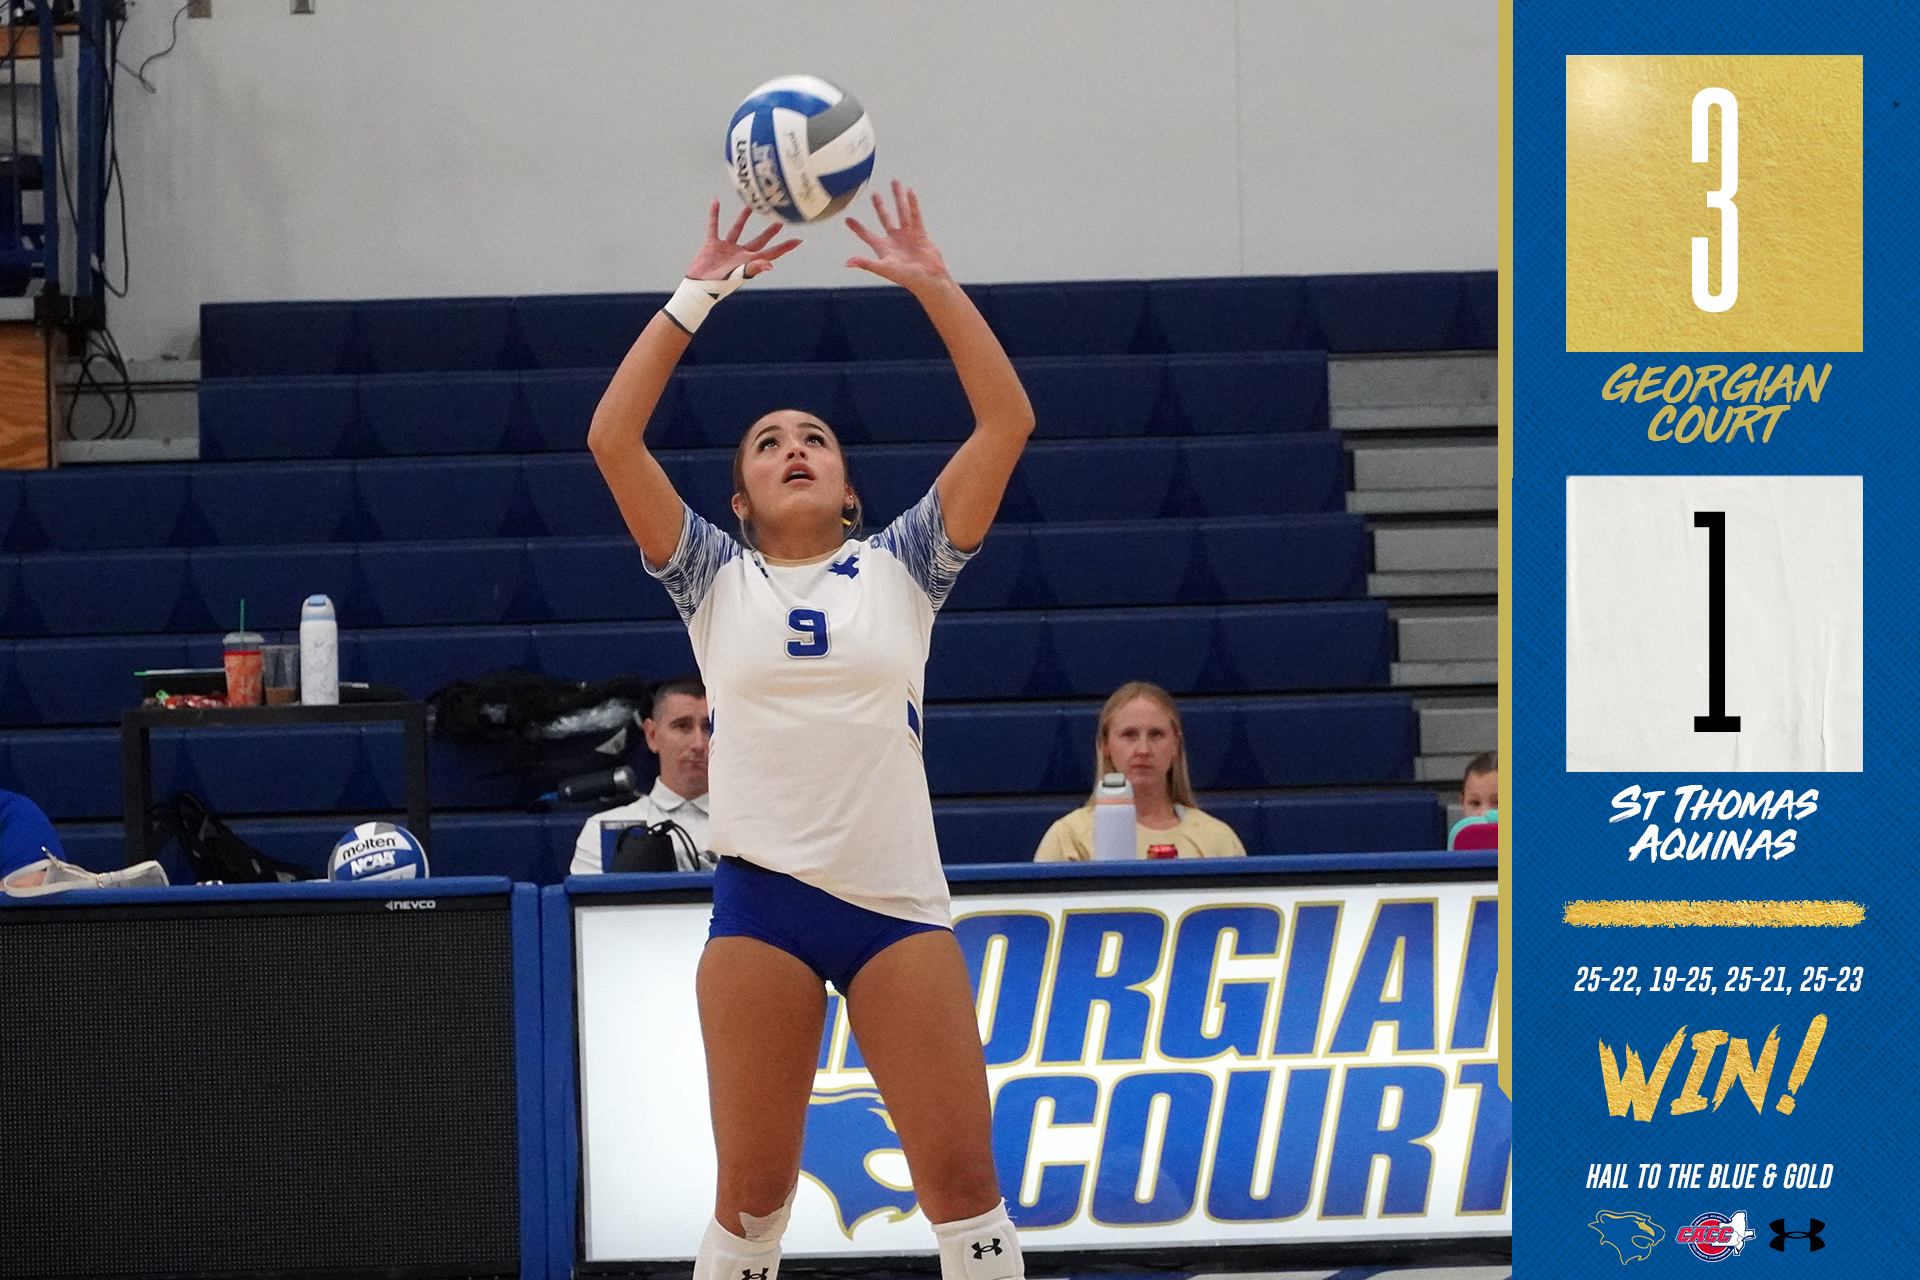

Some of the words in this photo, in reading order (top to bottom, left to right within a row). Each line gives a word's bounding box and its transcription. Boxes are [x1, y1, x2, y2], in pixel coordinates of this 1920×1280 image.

[784, 606, 831, 659] 9
[342, 836, 397, 861] molten
[350, 850, 396, 876] NCAA
[816, 895, 1498, 1075] ORGIA
